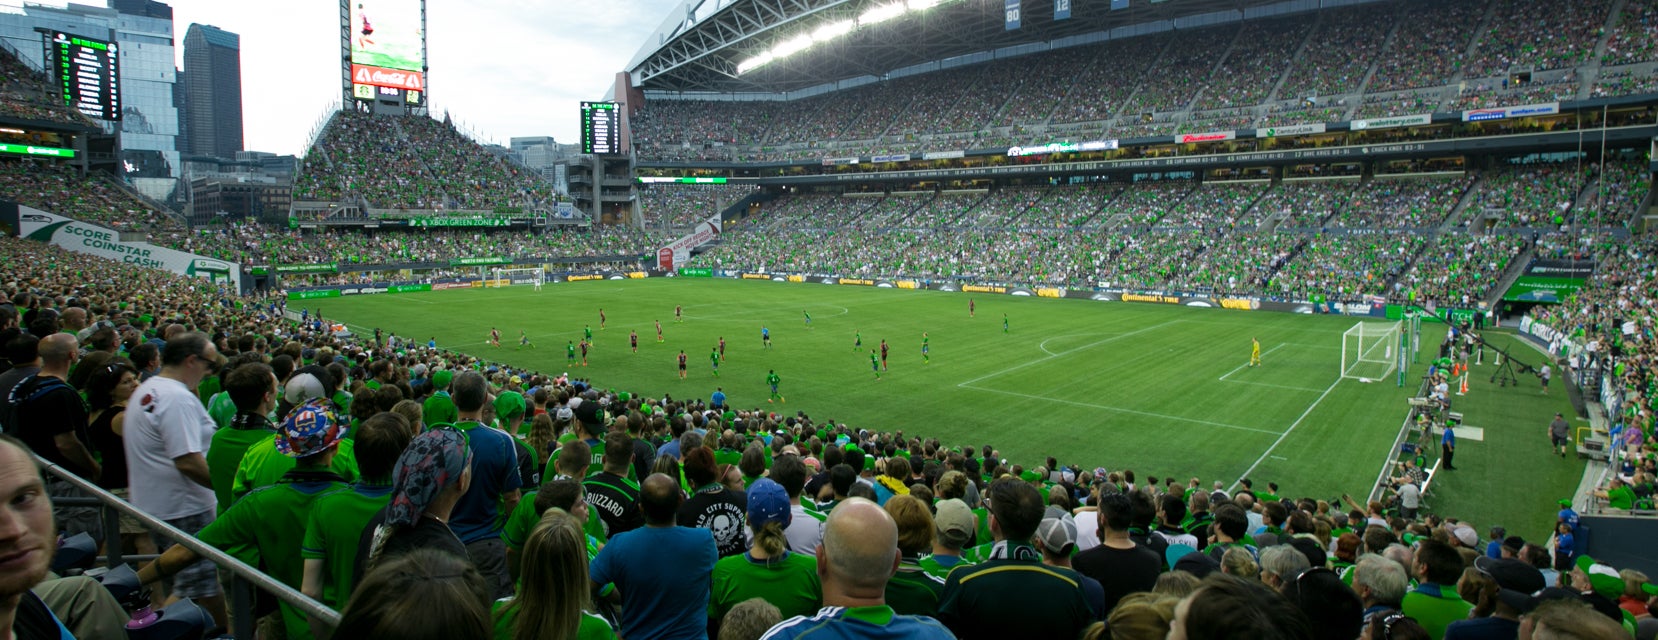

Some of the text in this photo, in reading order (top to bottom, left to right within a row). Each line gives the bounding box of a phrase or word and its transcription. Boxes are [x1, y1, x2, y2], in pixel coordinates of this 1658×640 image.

[1056, 0, 1068, 12] 12
[1006, 10, 1019, 22] 80
[65, 225, 112, 241] SCORE
[83, 238, 151, 257] COINSTAR
[123, 255, 164, 268] CASH!
[587, 493, 624, 517] BUZZARD
[706, 503, 722, 514] CITY
